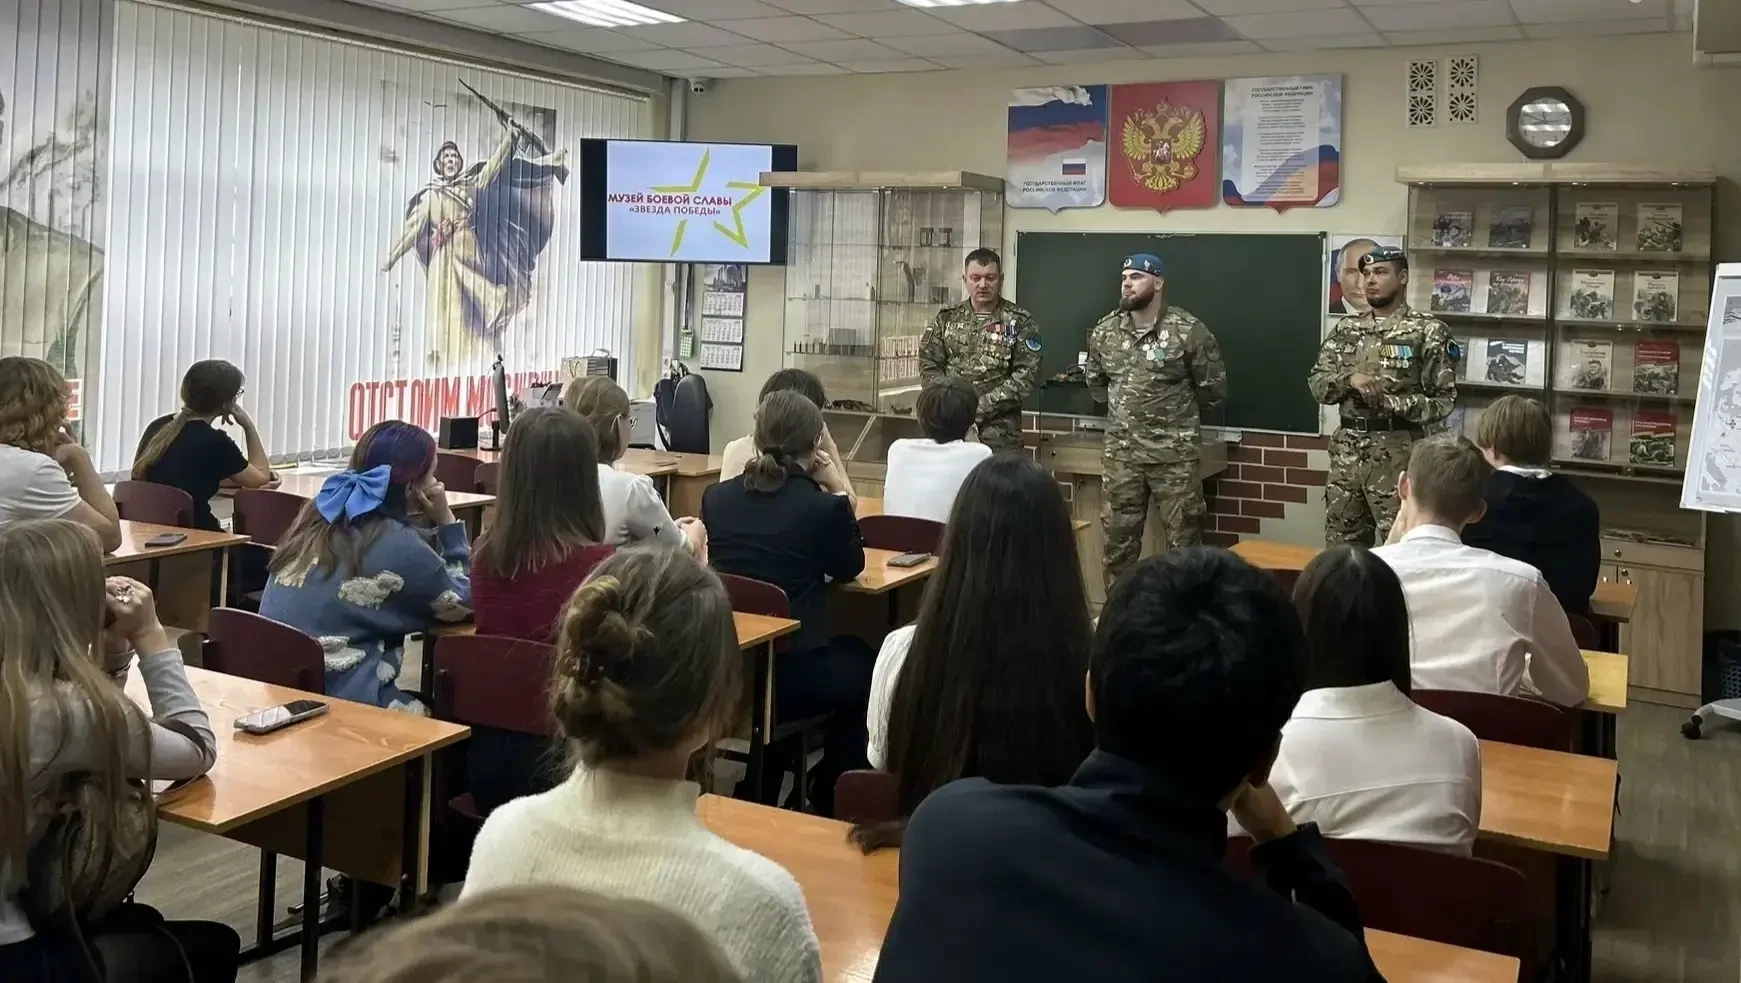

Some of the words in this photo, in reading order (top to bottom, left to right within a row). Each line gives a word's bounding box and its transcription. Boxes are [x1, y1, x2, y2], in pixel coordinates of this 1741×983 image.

[608, 192, 643, 203] МУЗЕЙ
[647, 193, 690, 205] БОЕВОЙ
[693, 196, 732, 206] СЛАВЫ
[629, 204, 671, 215] «ЗВЕЗДА
[673, 205, 721, 216] ПОБЕДЫ»
[349, 376, 461, 441] ОТСТОИМ
